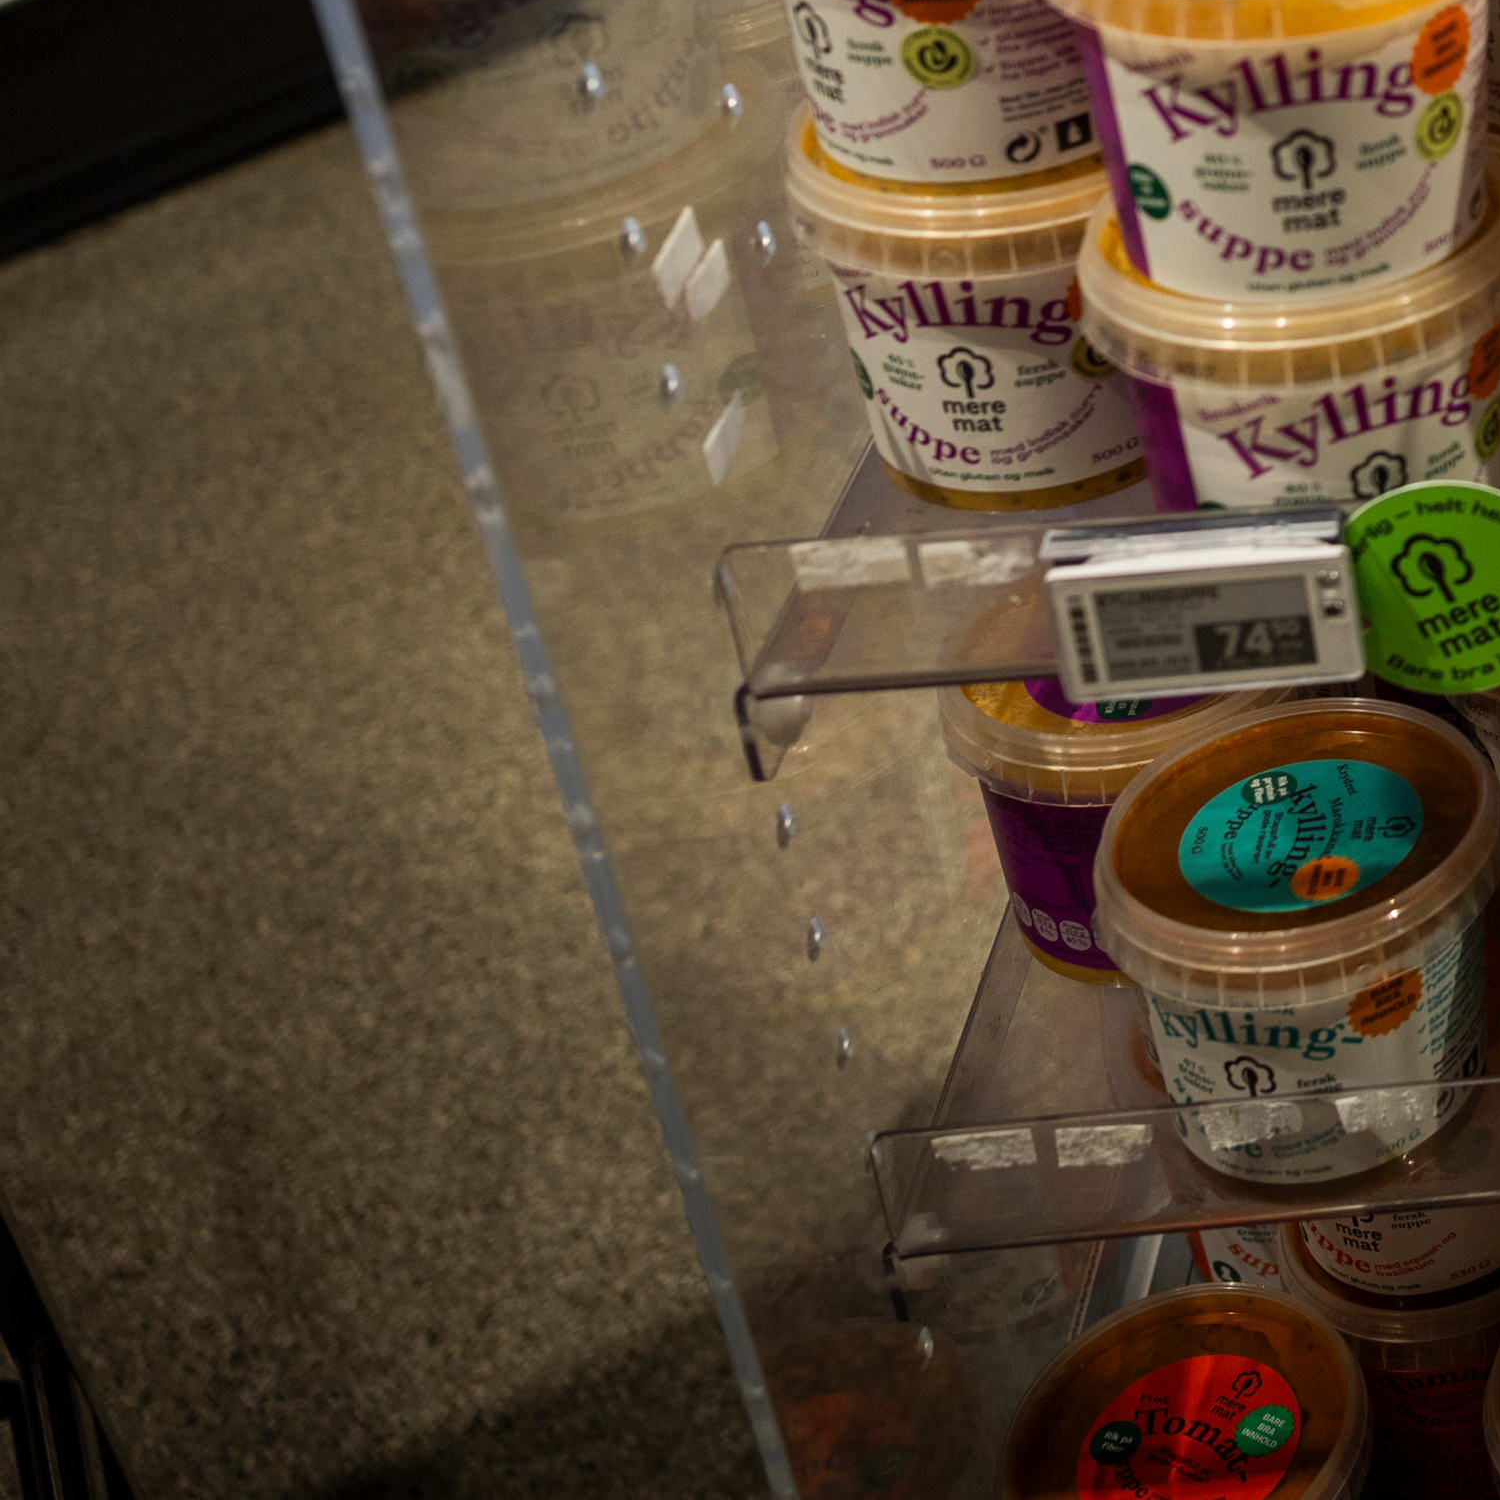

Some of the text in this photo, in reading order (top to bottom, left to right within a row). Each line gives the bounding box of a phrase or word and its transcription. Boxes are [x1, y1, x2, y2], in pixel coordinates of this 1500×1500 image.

[1143, 48, 1417, 145] Kylling
[1271, 188, 1346, 214] mere
[1282, 211, 1342, 234] mat
[1179, 201, 1316, 275] suppe
[843, 280, 1073, 345] Kylling
[943, 398, 1008, 417] mere
[874, 386, 983, 466] suppe
[953, 416, 1005, 434] mat
[1219, 372, 1471, 482] Kylling
[1216, 622, 1275, 660] 74
[1350, 818, 1365, 841] mat
[1362, 815, 1378, 843] mere
[1151, 996, 1364, 1062] kylling-
[1334, 1220, 1384, 1241] mere
[1342, 1235, 1382, 1253] mat
[1210, 1404, 1238, 1423] mat
[1214, 1392, 1247, 1414] mere
[1255, 1421, 1278, 1437] BRA
[1260, 1412, 1288, 1429] BARE
[1100, 1440, 1126, 1455] fiber
[1102, 1429, 1134, 1448] Rik på
[1135, 1405, 1248, 1483] Tomat-
[1241, 1426, 1279, 1450] INNHOLD
